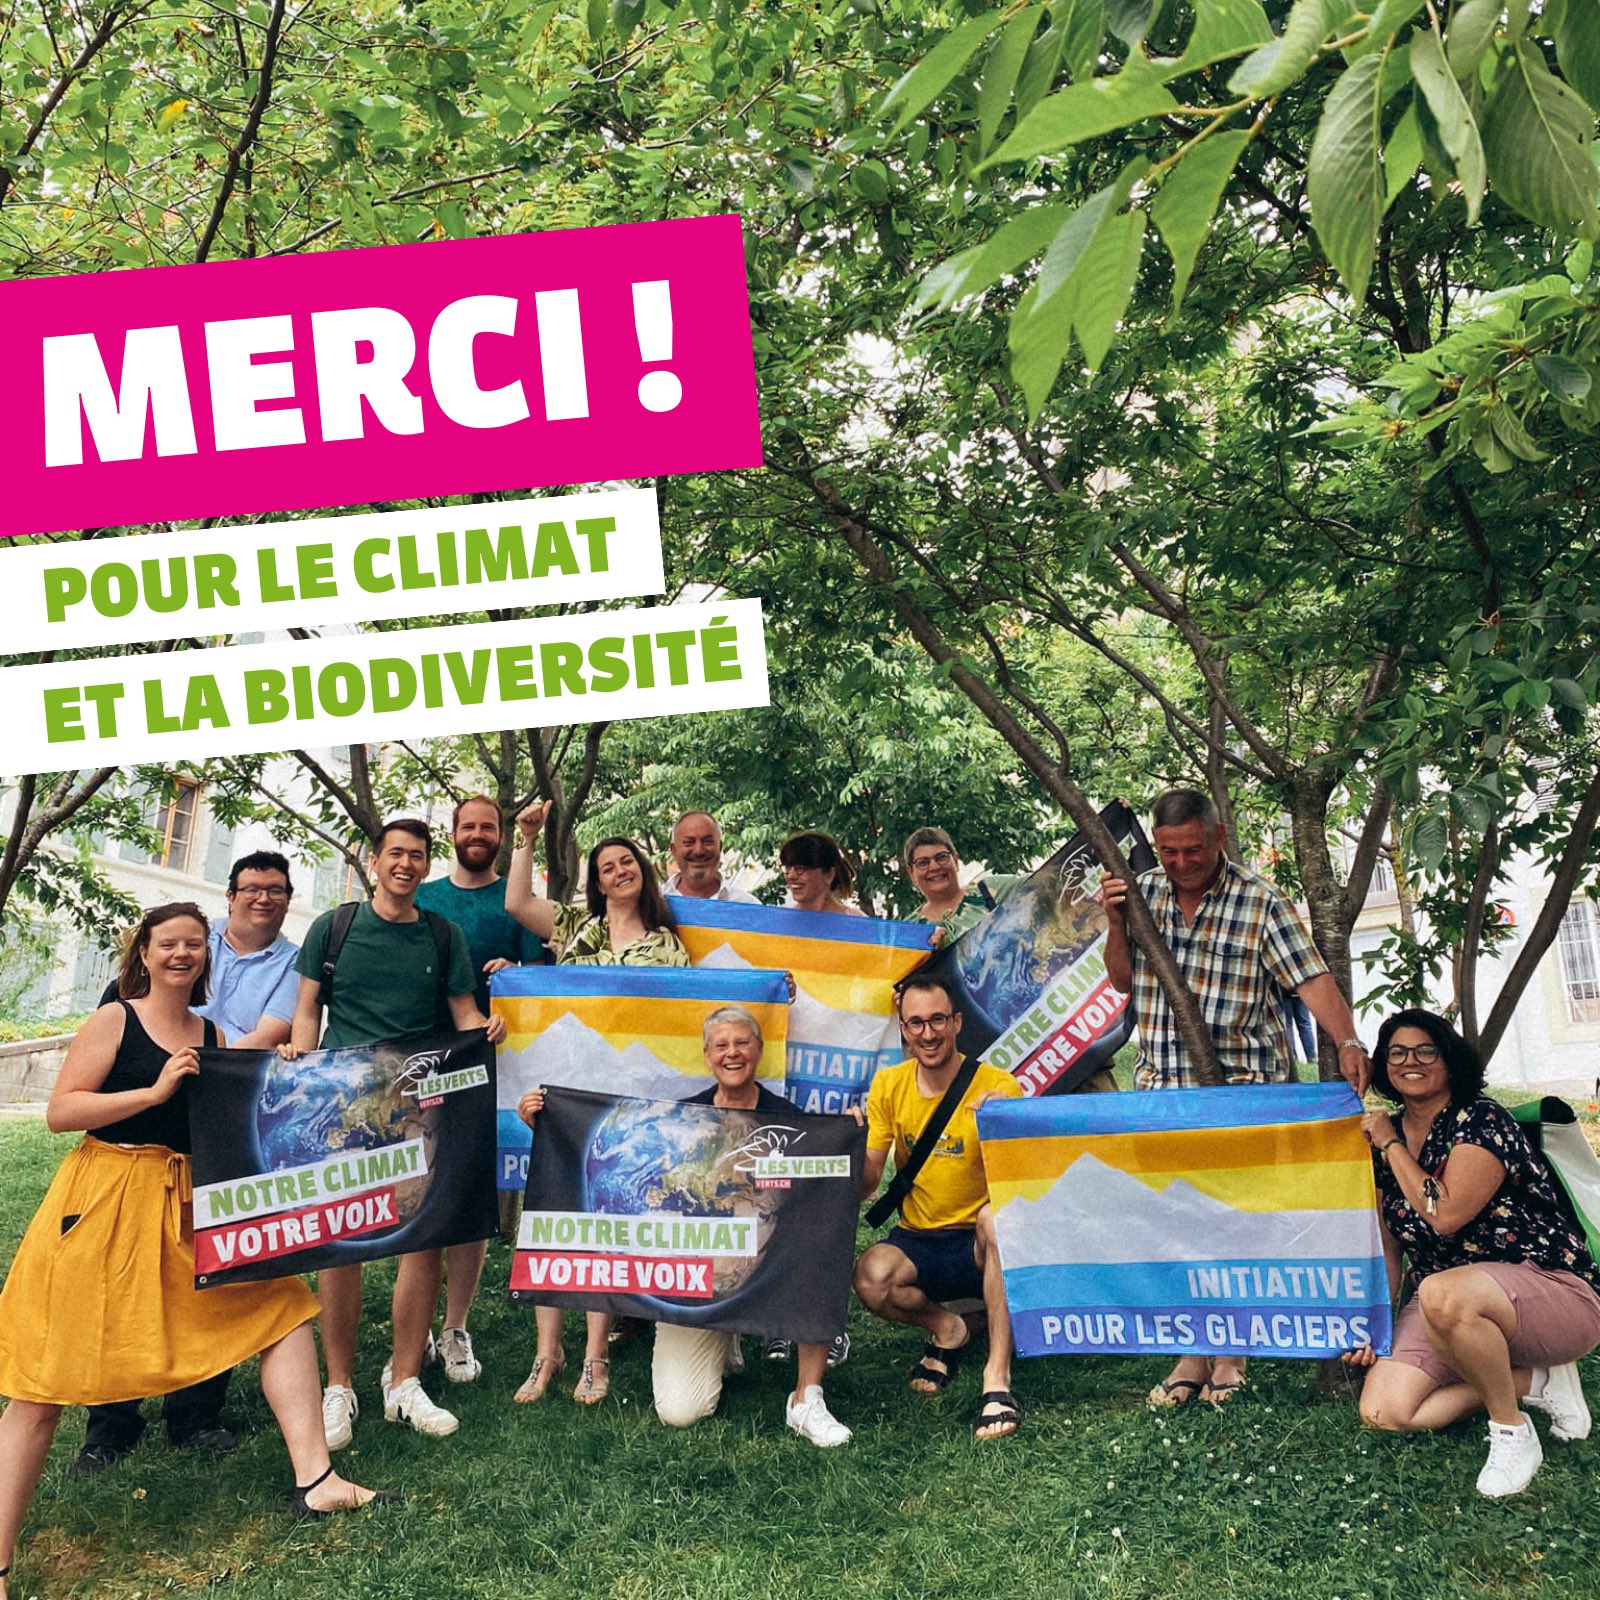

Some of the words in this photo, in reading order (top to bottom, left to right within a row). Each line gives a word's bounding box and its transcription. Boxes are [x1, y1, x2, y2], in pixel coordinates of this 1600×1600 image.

[990, 1007, 1053, 1069] OTRE
[1016, 1034, 1078, 1097] OTRE
[1067, 984, 1128, 1042] VOIX
[420, 1078, 442, 1096] LES
[444, 1068, 486, 1088] VERTS
[208, 1169, 317, 1219] NOTRE
[323, 1145, 420, 1193] CLIMAT
[504, 1154, 530, 1180] PO
[758, 1158, 788, 1175] LES
[792, 1158, 848, 1175] VERTS
[755, 1180, 791, 1189] VERTS.CH
[212, 1212, 321, 1264] VOTRE
[325, 1193, 394, 1236] VOIX
[531, 1216, 632, 1246] NOTRE
[636, 1221, 750, 1250] CLIMAT
[528, 1258, 629, 1288] VOTRE
[635, 1261, 707, 1292] VOIX
[1187, 1266, 1365, 1299] INITIATIVE
[1042, 1314, 1126, 1345] POUR
[1135, 1314, 1195, 1345] LES
[1206, 1314, 1371, 1349] GLACIERS
